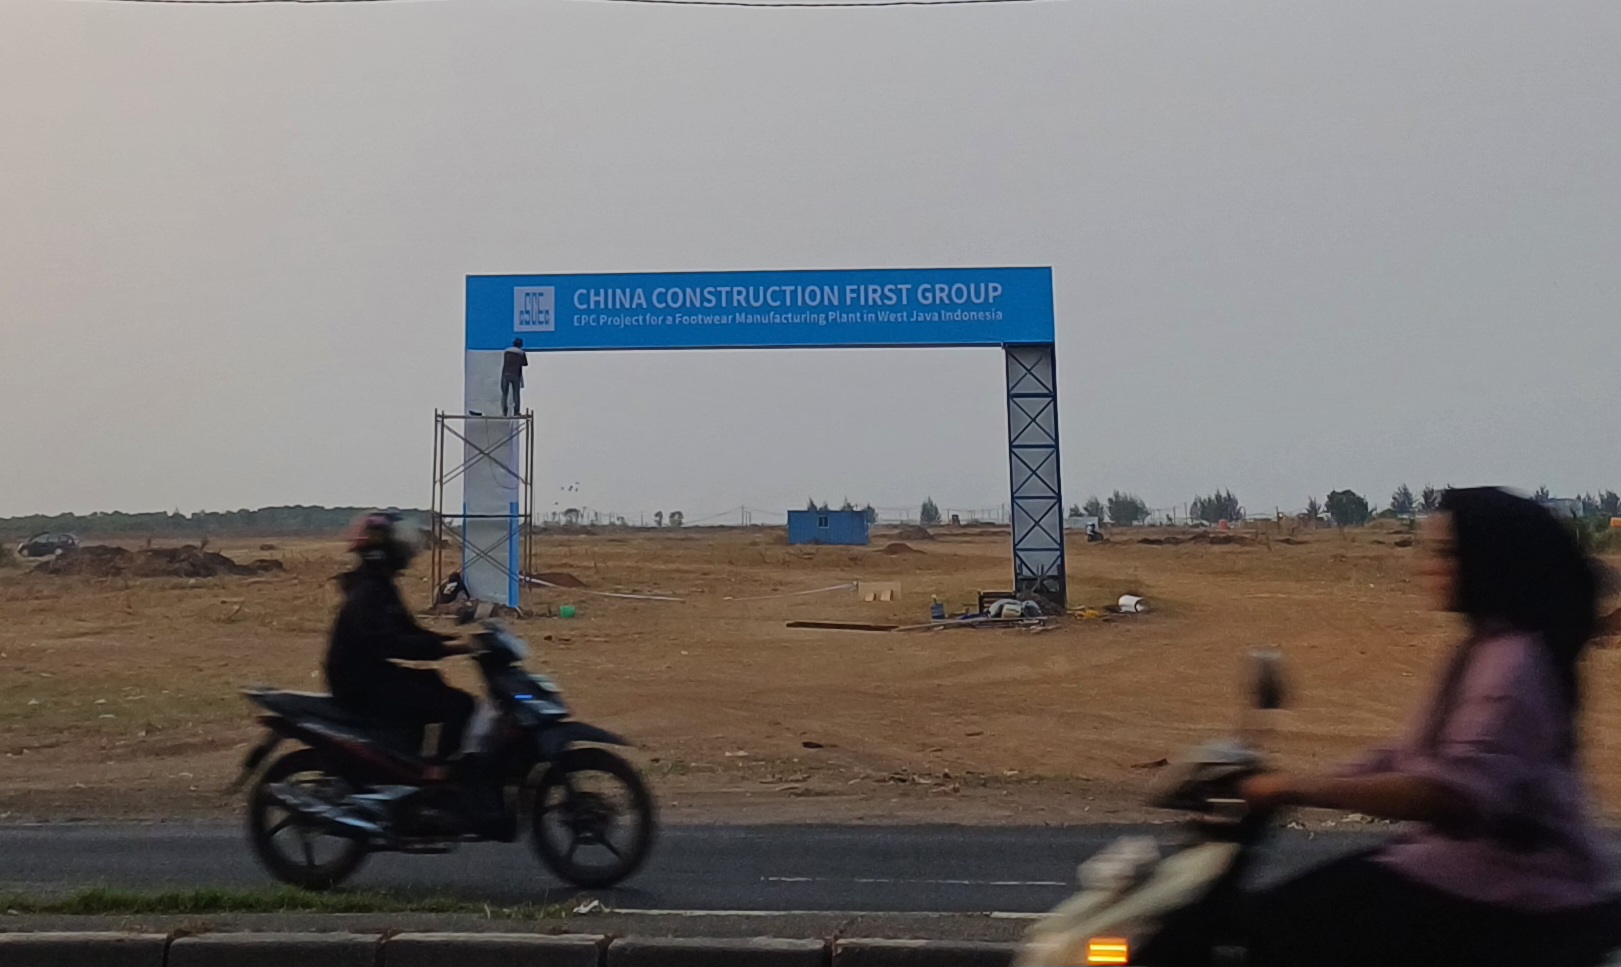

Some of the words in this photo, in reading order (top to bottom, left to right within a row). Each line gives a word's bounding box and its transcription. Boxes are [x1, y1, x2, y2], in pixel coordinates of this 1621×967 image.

[573, 288, 648, 310] CHINA
[652, 285, 839, 309] CONSTRUCTION
[845, 284, 912, 306] FIRST
[917, 282, 1003, 305] GROUP
[573, 315, 597, 326] EPC
[600, 314, 643, 328] Project
[646, 313, 663, 325] for
[666, 315, 673, 325] a
[676, 313, 733, 325] Footwear
[736, 311, 826, 326] Manufacturing
[828, 310, 861, 323] Plant
[863, 310, 875, 322] in
[877, 310, 907, 322] West
[910, 310, 939, 322] Java
[941, 308, 1003, 321] Indonesia
